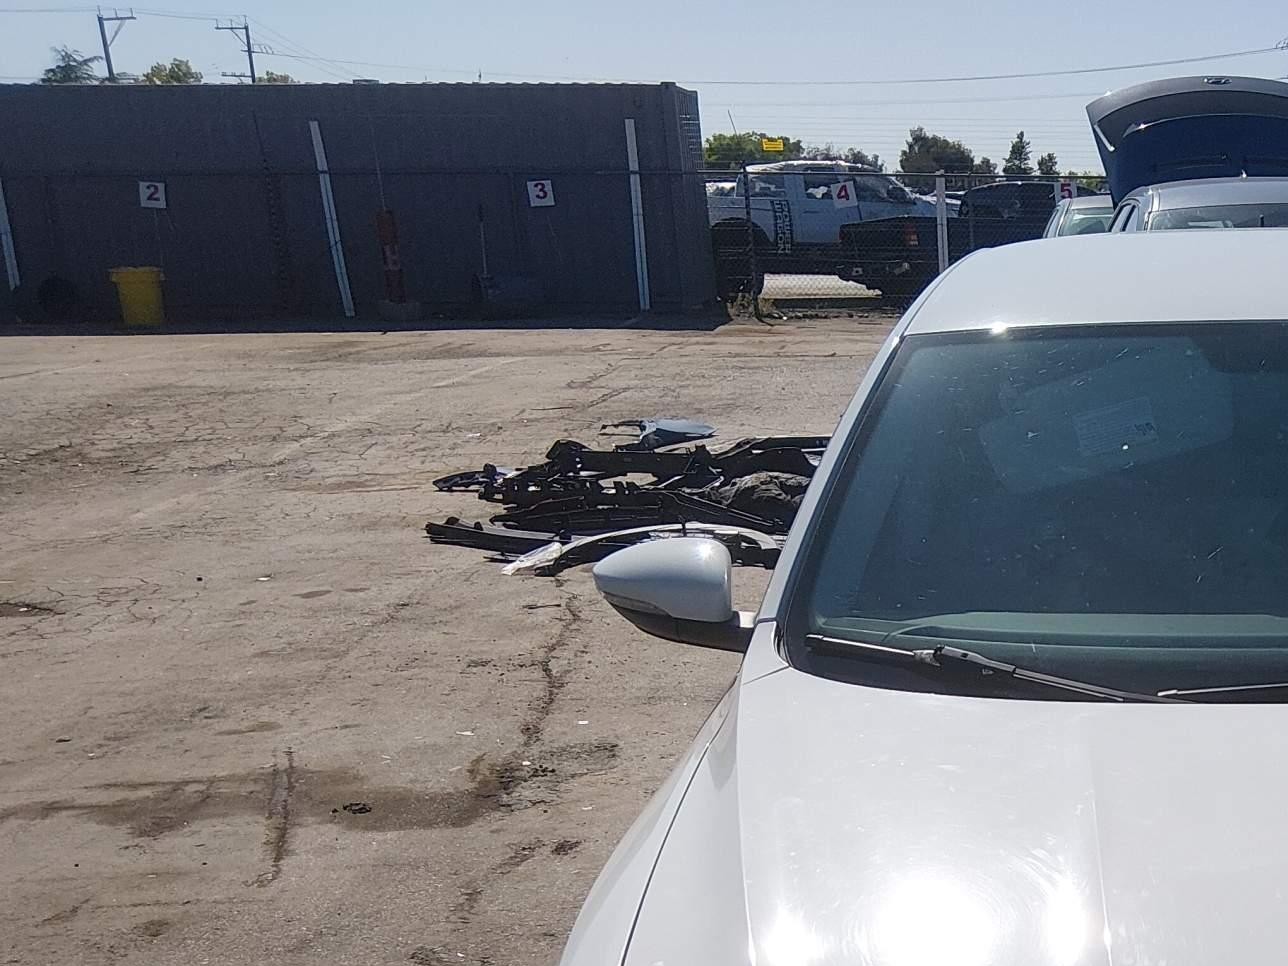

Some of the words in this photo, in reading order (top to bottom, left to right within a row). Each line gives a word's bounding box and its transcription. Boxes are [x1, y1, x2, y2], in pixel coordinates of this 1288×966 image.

[146, 184, 160, 201] 2
[534, 183, 548, 200] 3
[837, 184, 850, 200] 4
[1060, 183, 1072, 200] 5
